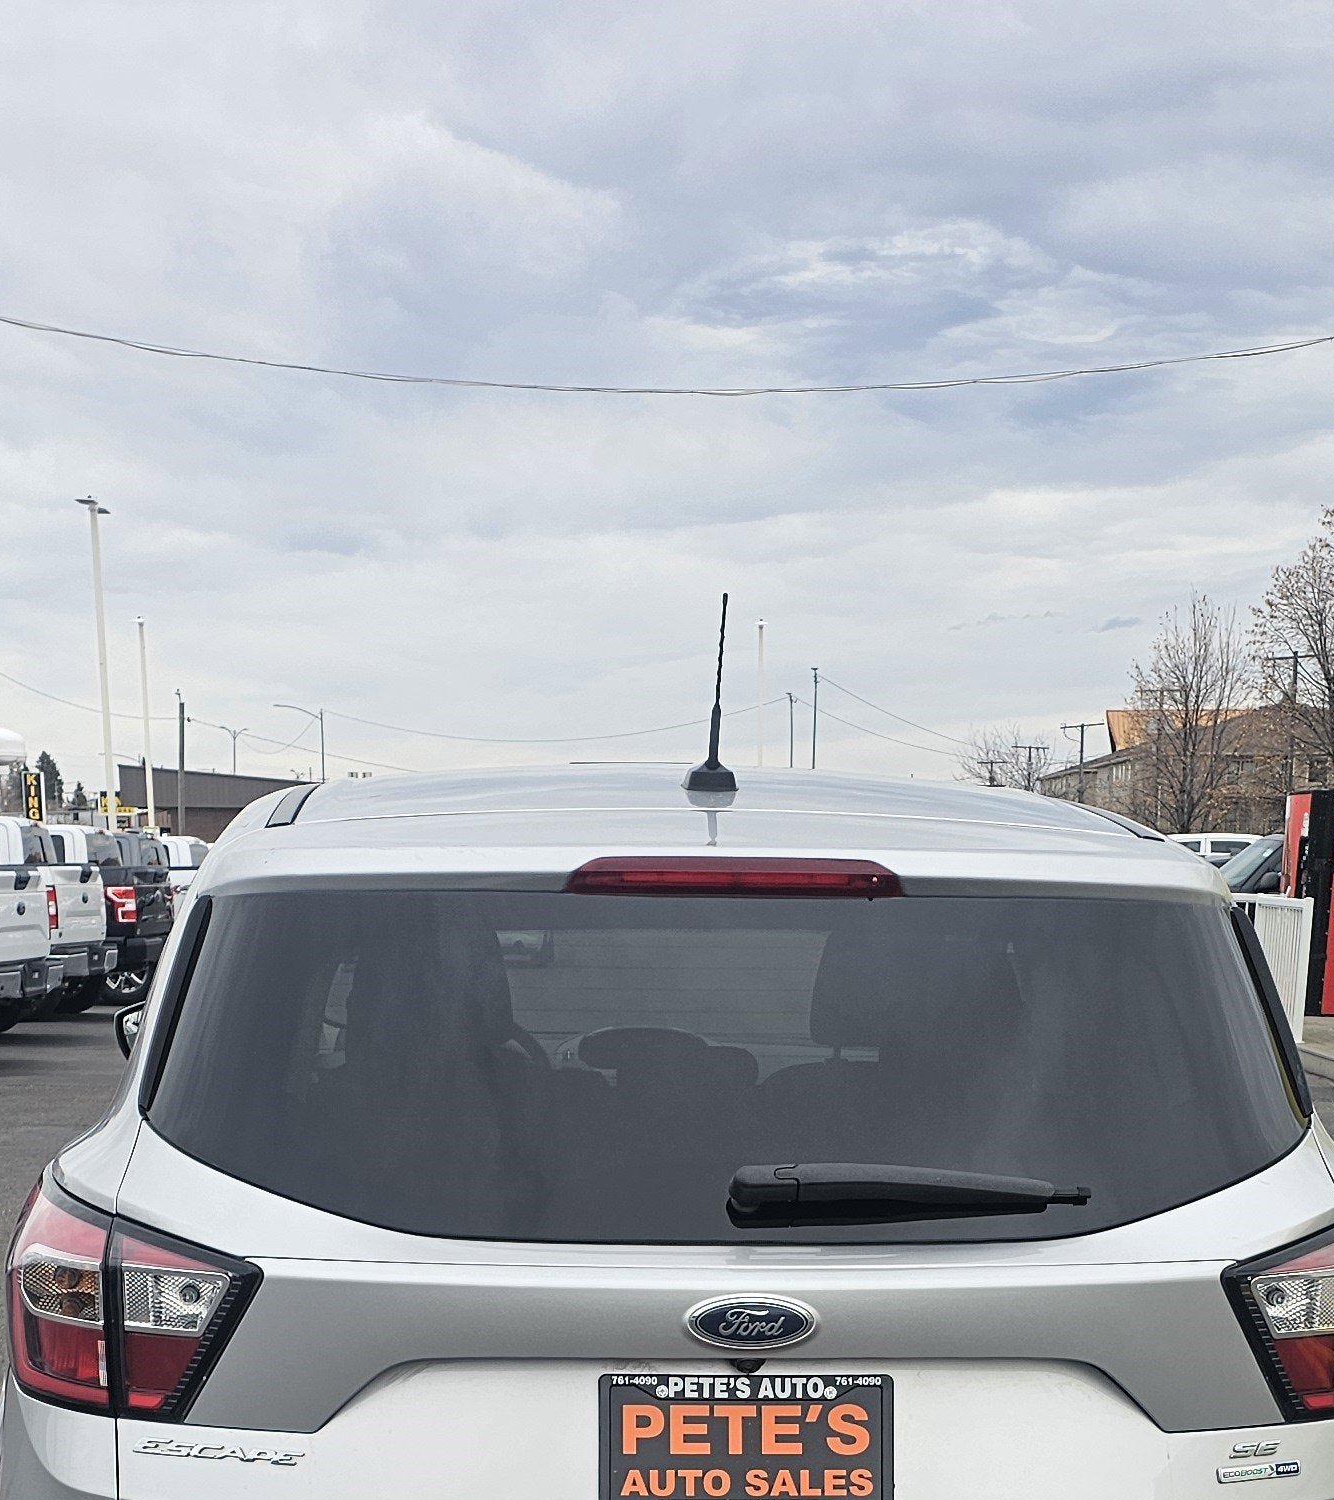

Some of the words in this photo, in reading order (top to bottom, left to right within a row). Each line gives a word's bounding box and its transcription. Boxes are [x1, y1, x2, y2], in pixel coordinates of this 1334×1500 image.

[26, 773, 40, 820] KING
[718, 1308, 786, 1338] Ford
[611, 1375, 658, 1386] 761-4090
[668, 1377, 750, 1399] PETE'S
[757, 1377, 824, 1399] AUTO
[834, 1376, 882, 1386] 761-4090
[622, 1404, 871, 1456] PETE'S
[133, 1437, 306, 1466] ESCAPE
[1228, 1439, 1282, 1459] SE
[1277, 1463, 1299, 1474] 4WD
[620, 1469, 732, 1497] AUTO
[744, 1469, 874, 1497] SALES
